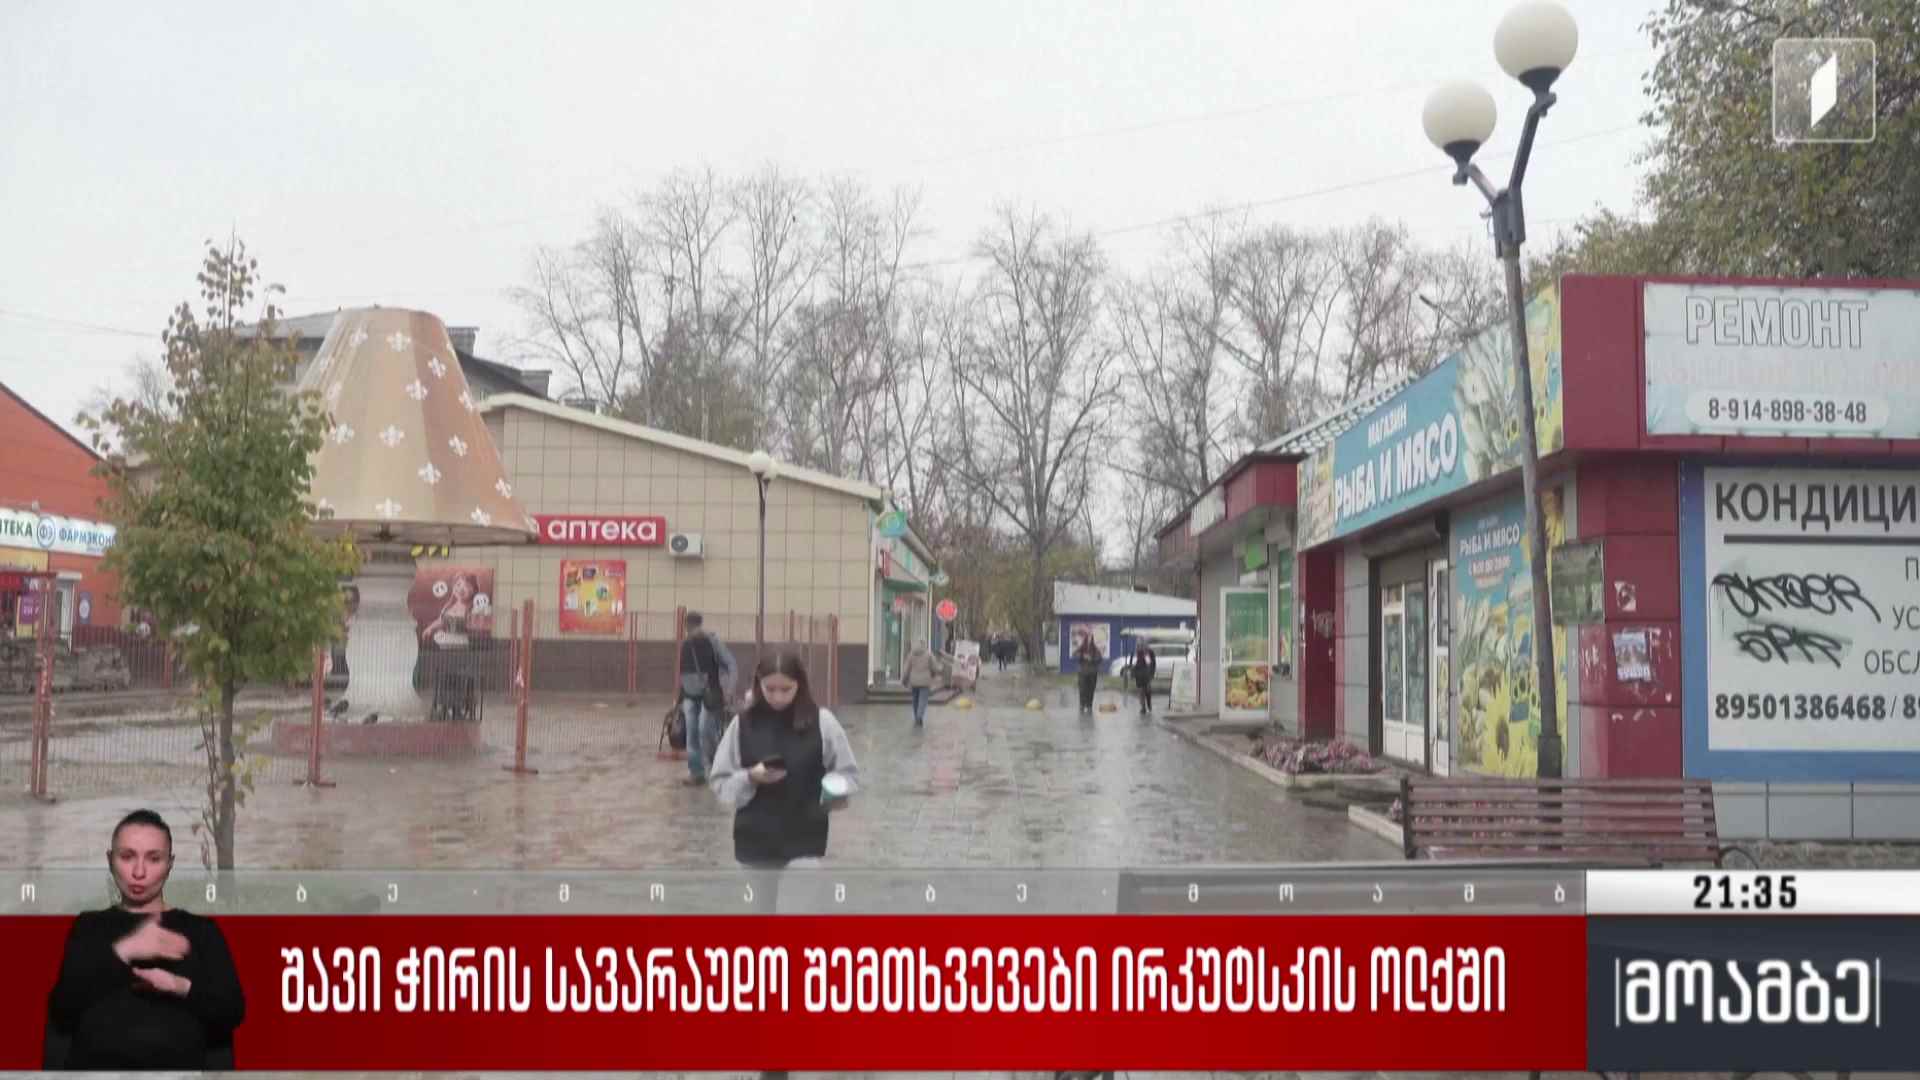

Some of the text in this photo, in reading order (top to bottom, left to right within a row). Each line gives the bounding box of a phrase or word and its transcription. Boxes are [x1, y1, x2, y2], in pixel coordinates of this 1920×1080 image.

[1685, 296, 1868, 350] РЕМОНТ
[1708, 398, 1867, 424] 8-914-898-38-48
[1334, 412, 1458, 523] РЫБА И МЯСО
[1715, 482, 1917, 532] КОНДИЦИ
[0, 519, 33, 538] ТЕКА
[547, 520, 657, 541] аптека
[1715, 693, 1887, 720] 89501386468
